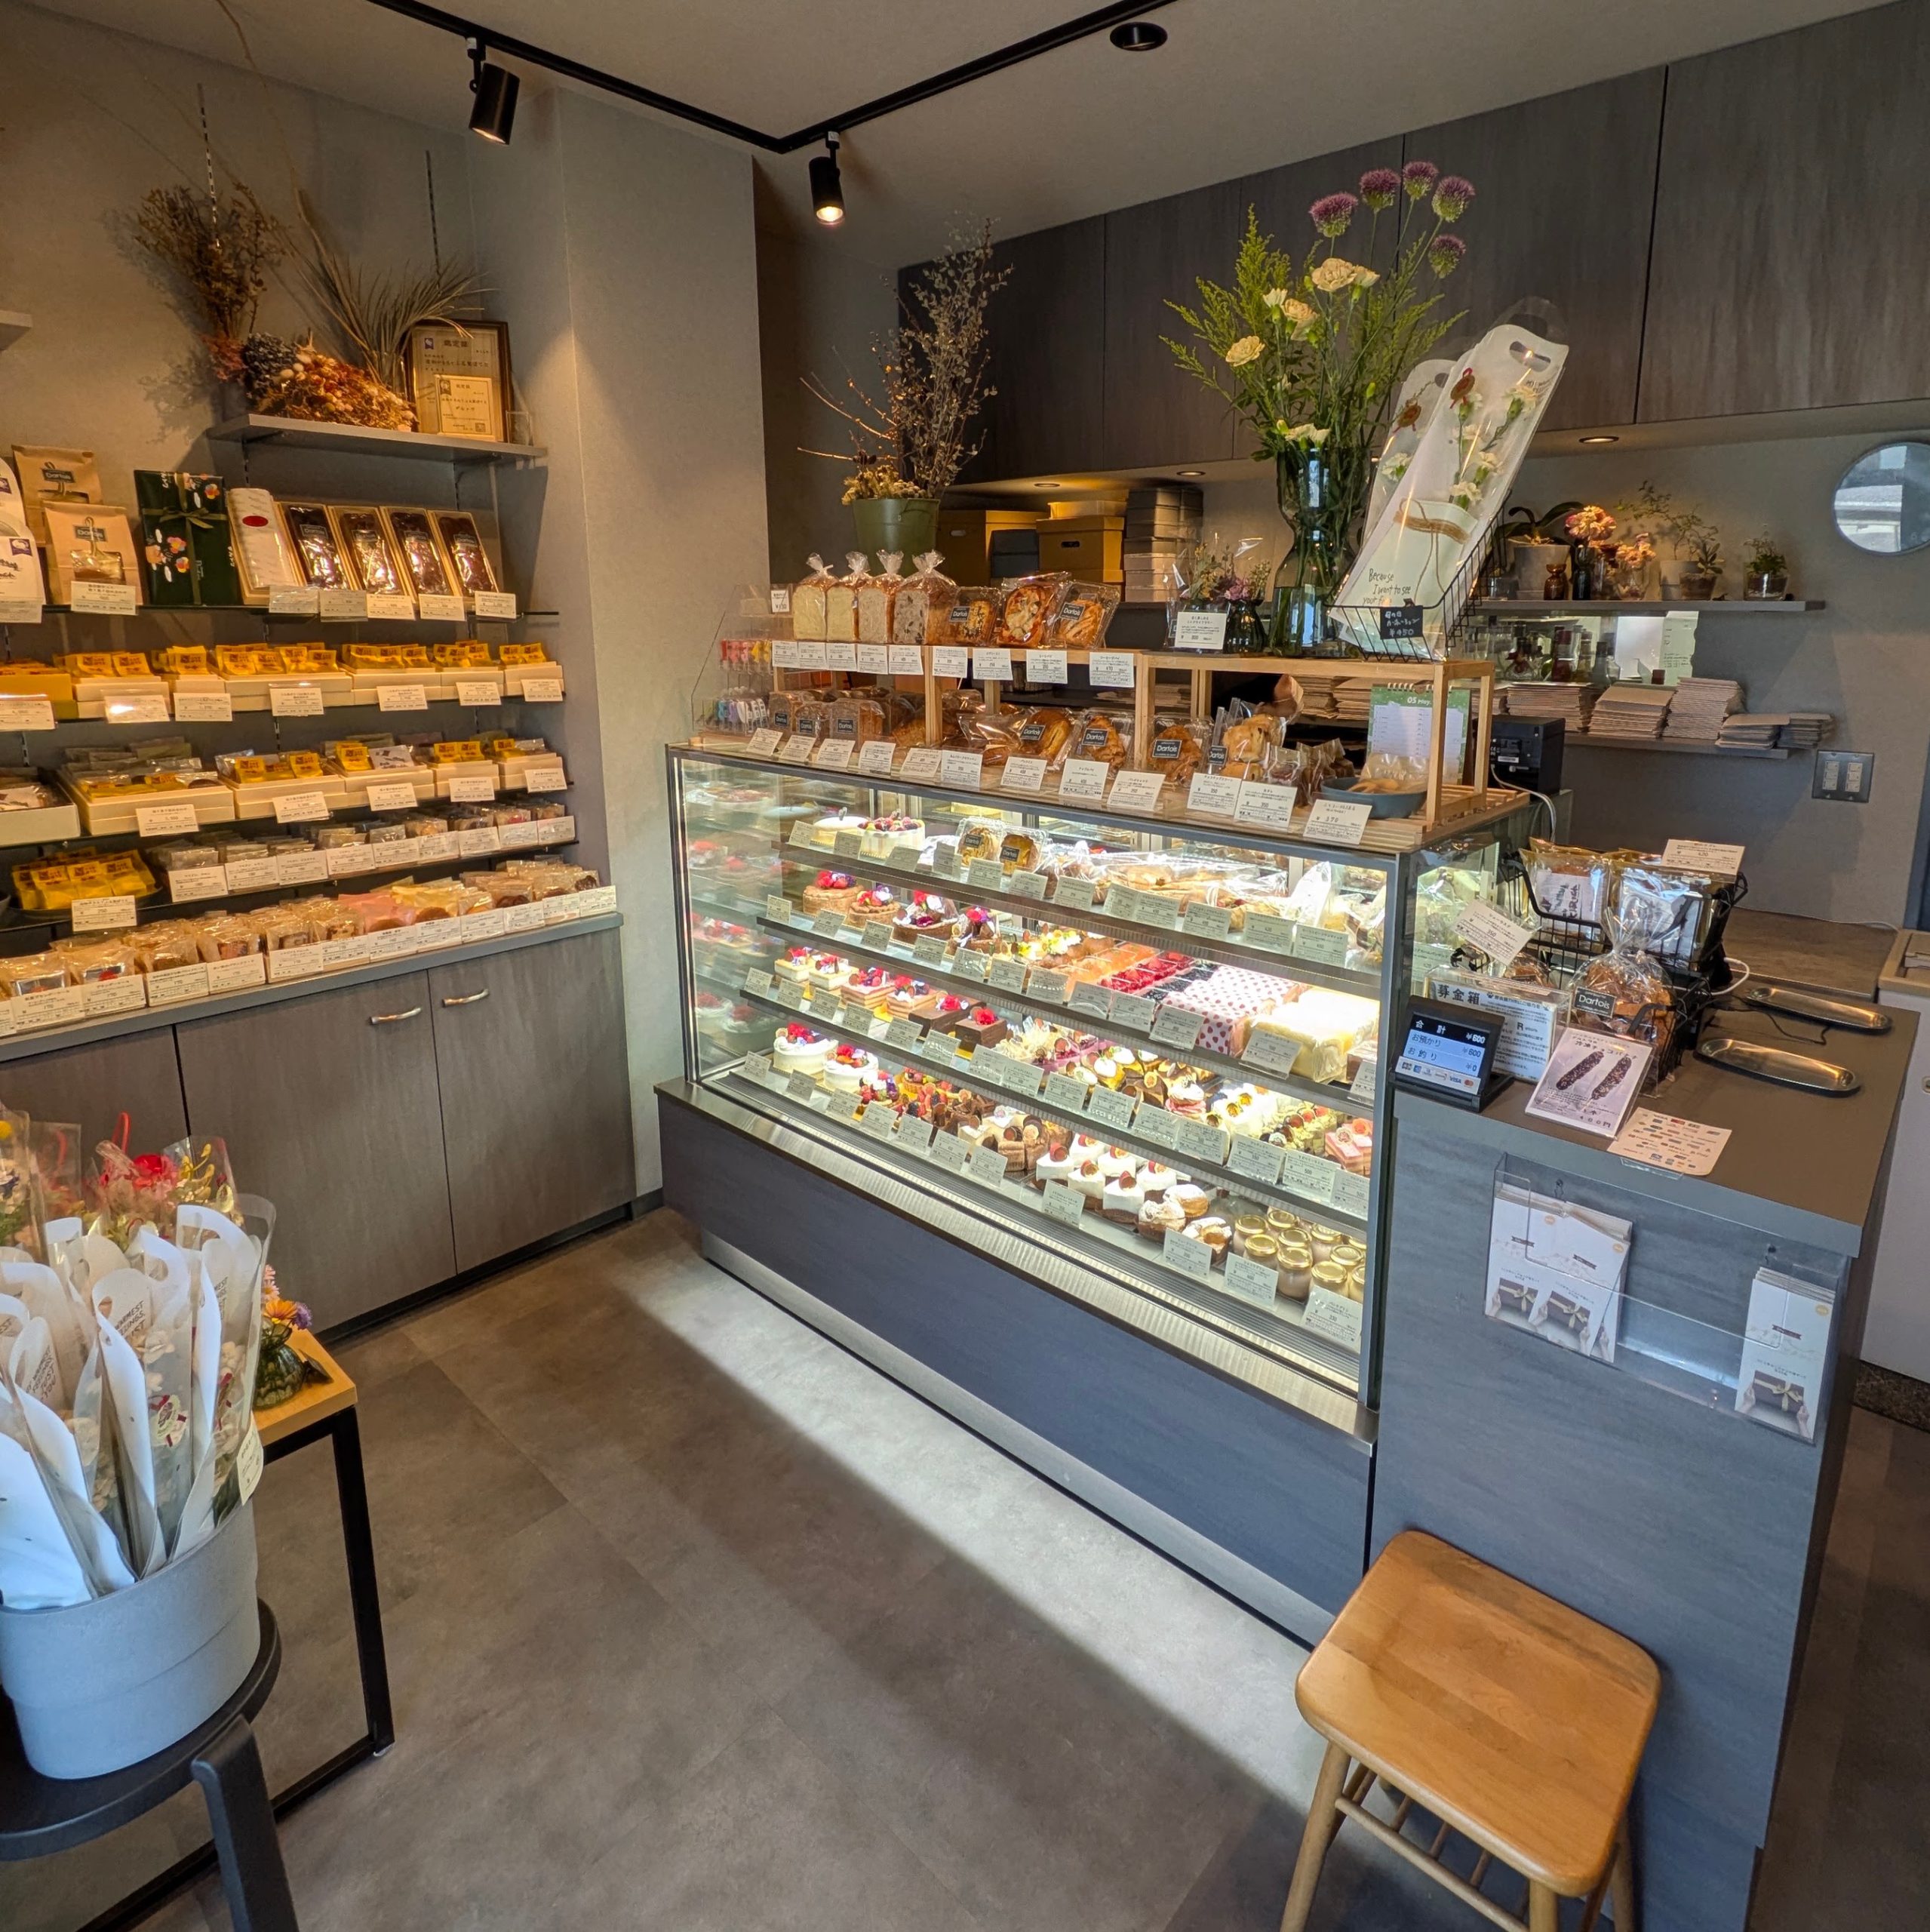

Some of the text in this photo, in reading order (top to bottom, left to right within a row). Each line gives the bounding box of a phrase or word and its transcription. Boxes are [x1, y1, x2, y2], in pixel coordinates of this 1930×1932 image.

[1369, 568, 1394, 583] Because
[1378, 585, 1394, 595] want
[1402, 586, 1412, 595] see
[1063, 607, 1081, 616] Dartois
[1407, 696, 1417, 704] 05
[1157, 744, 1178, 752] Dartois
[1437, 983, 1480, 1006] 募金箱
[1578, 994, 1610, 1010] Dartois
[1415, 1020, 1486, 1044] 合計 ¥600
[1412, 1033, 1441, 1048] お預かり
[1449, 1075, 1462, 1084] VISA
